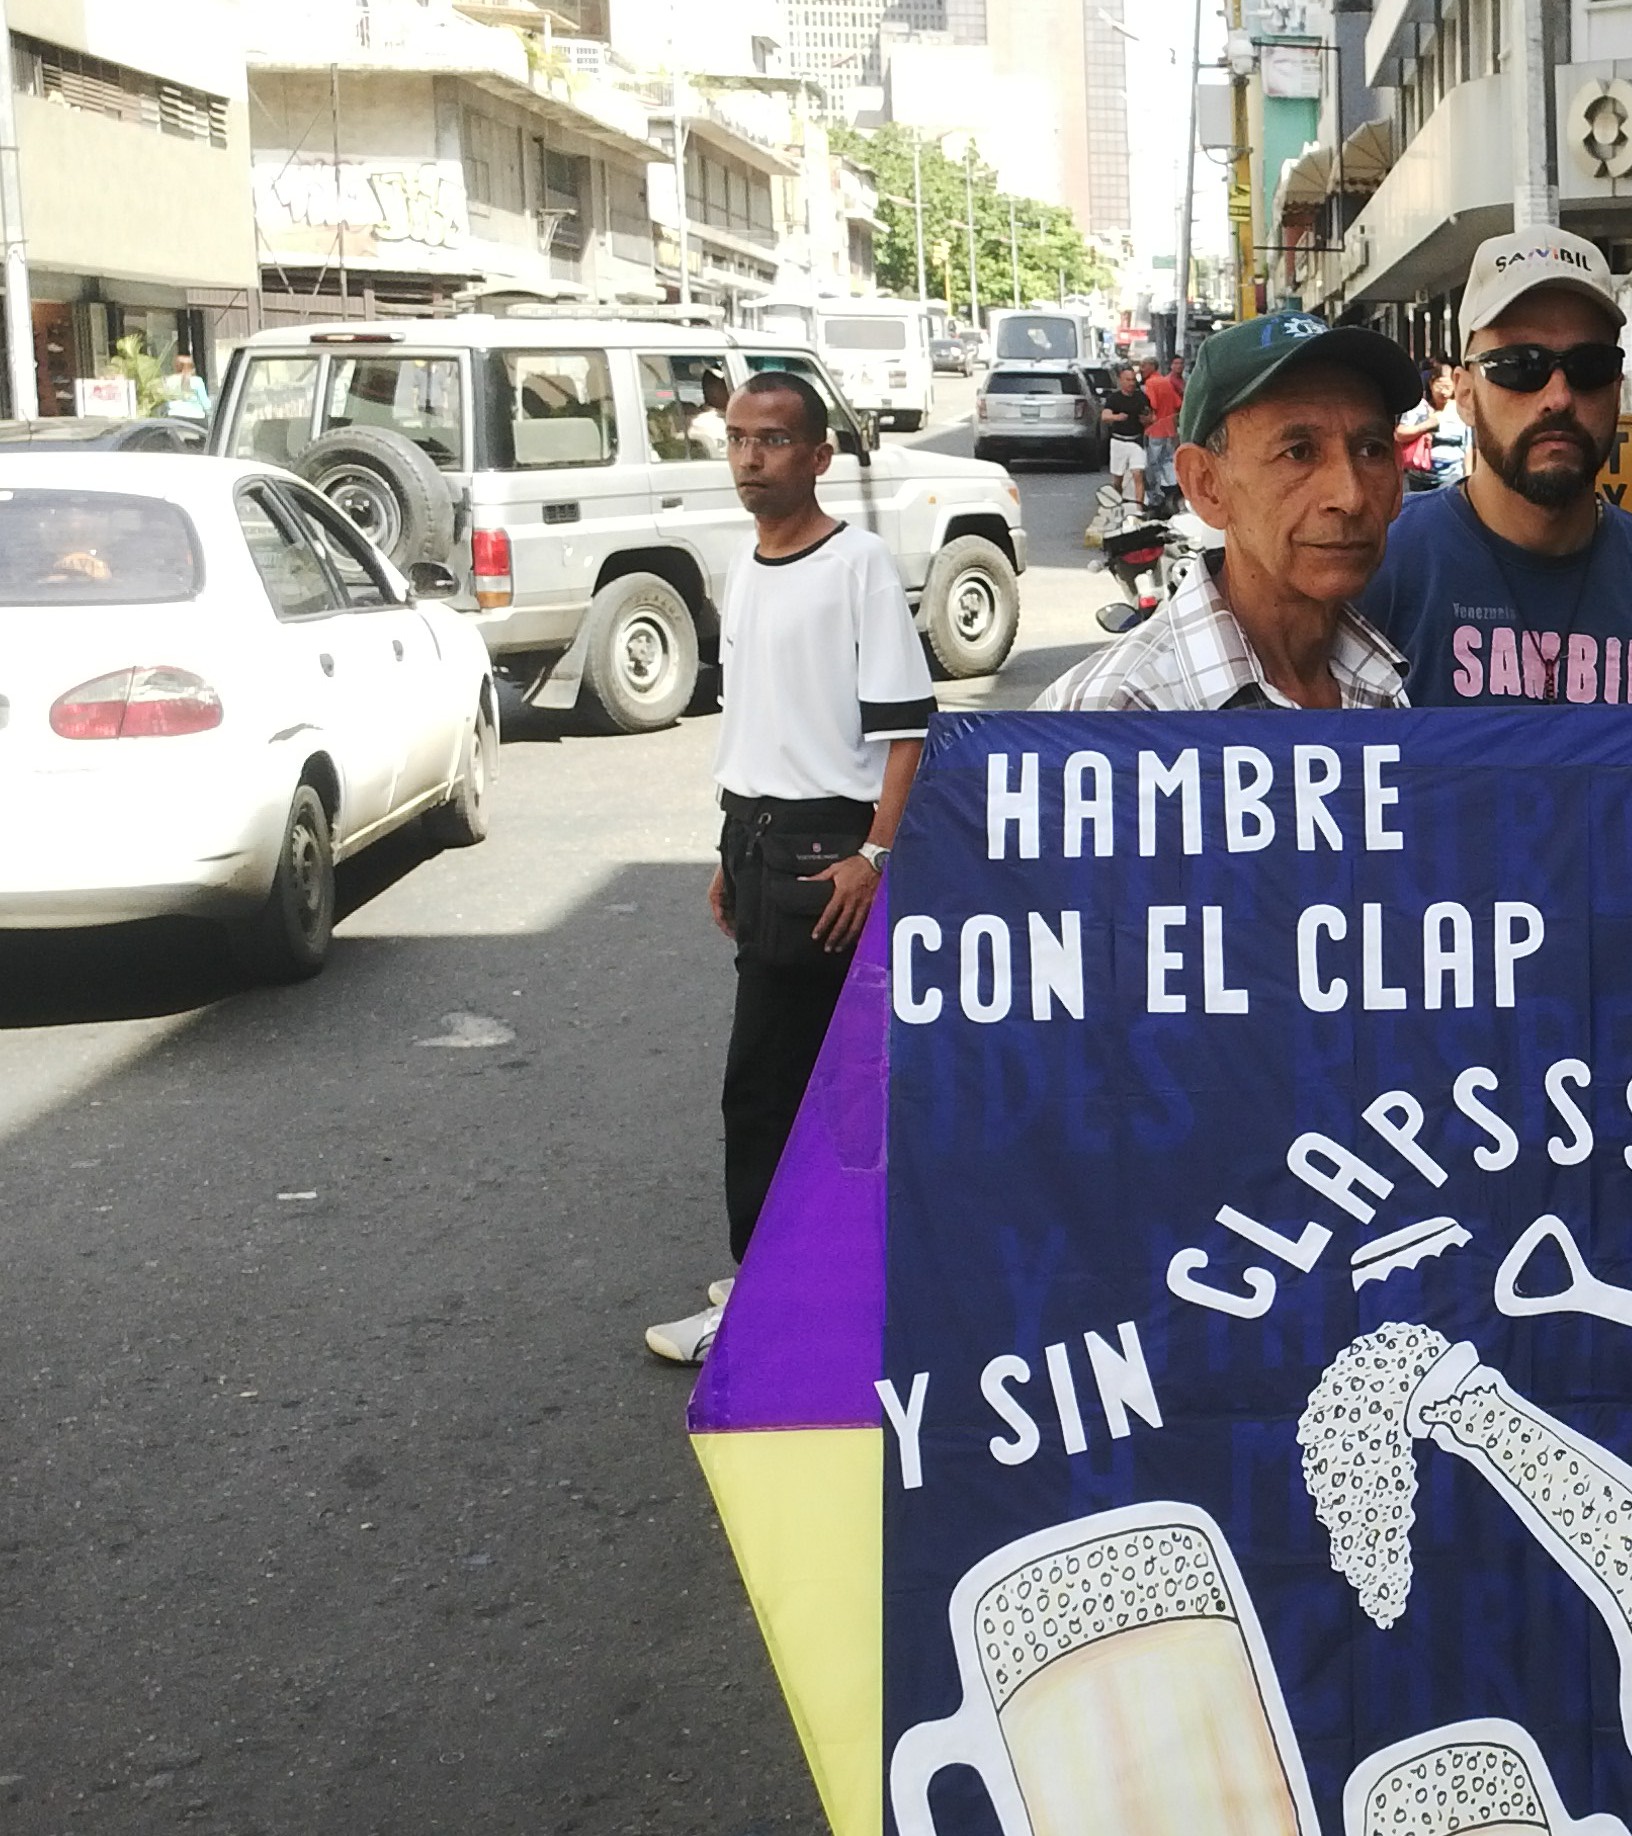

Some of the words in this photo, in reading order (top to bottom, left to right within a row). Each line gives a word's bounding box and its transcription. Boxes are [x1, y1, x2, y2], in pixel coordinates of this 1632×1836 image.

[988, 744, 1404, 860] HAMBRE
[893, 910, 1085, 1025] CON
[1147, 904, 1250, 1014] EL
[1297, 901, 1545, 1013] CLAP
[874, 1371, 930, 1490] Y
[981, 1320, 1164, 1466] SIN
